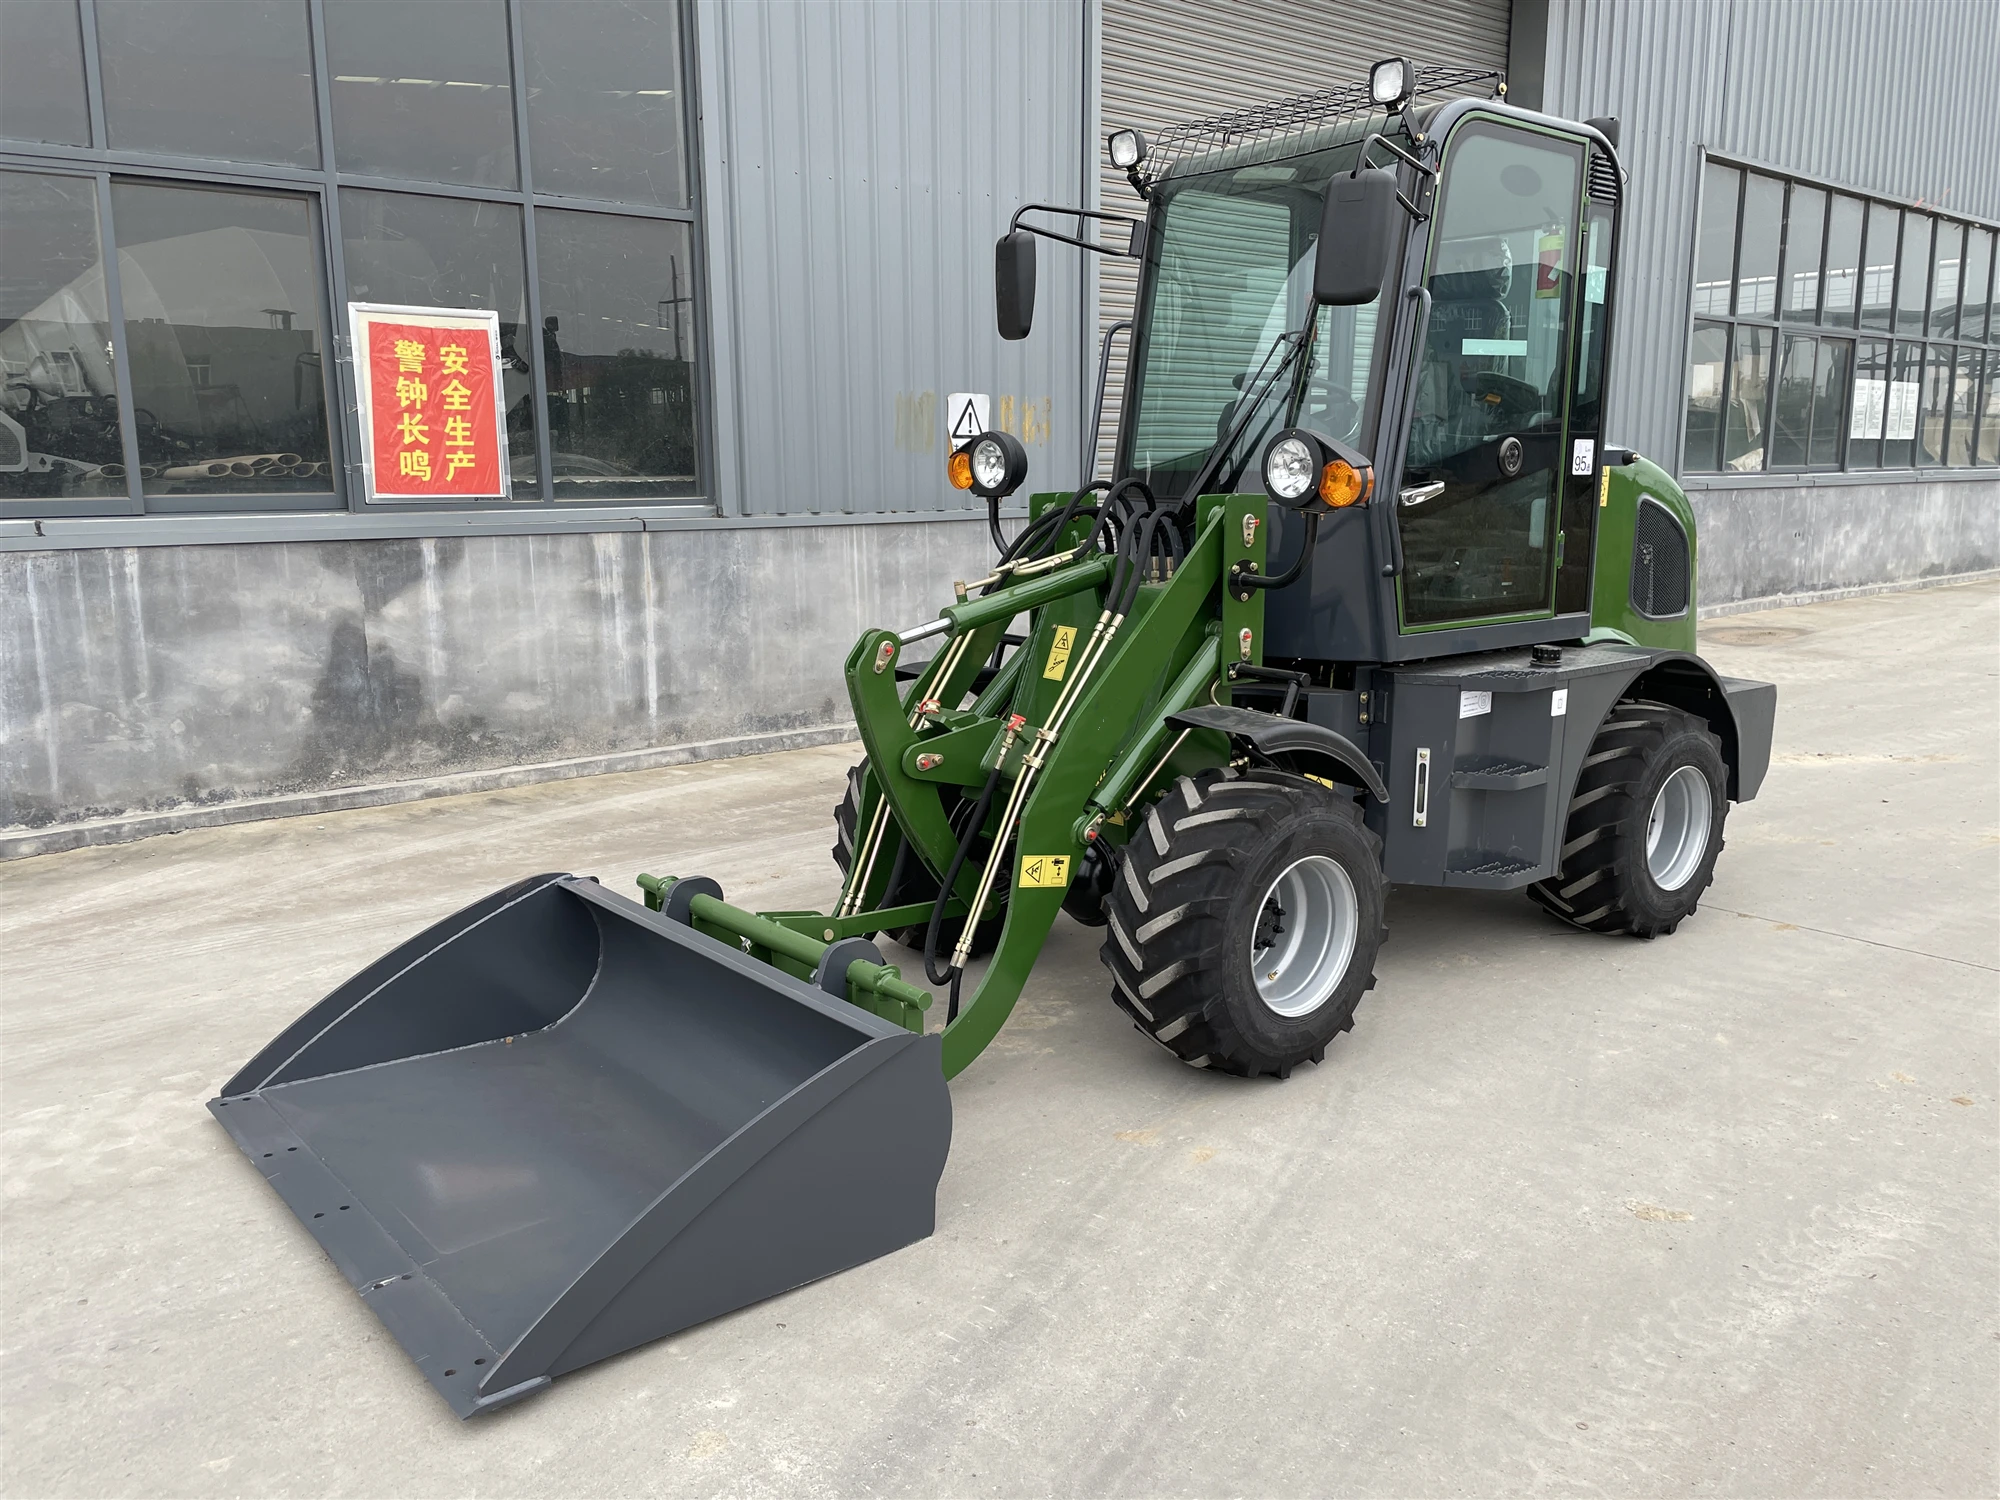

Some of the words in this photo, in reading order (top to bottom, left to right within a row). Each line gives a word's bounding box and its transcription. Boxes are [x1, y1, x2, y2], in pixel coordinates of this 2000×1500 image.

[394, 340, 431, 481] 警钟长鸣
[440, 344, 475, 481] 安全生产
[1574, 455, 1587, 472] 95
